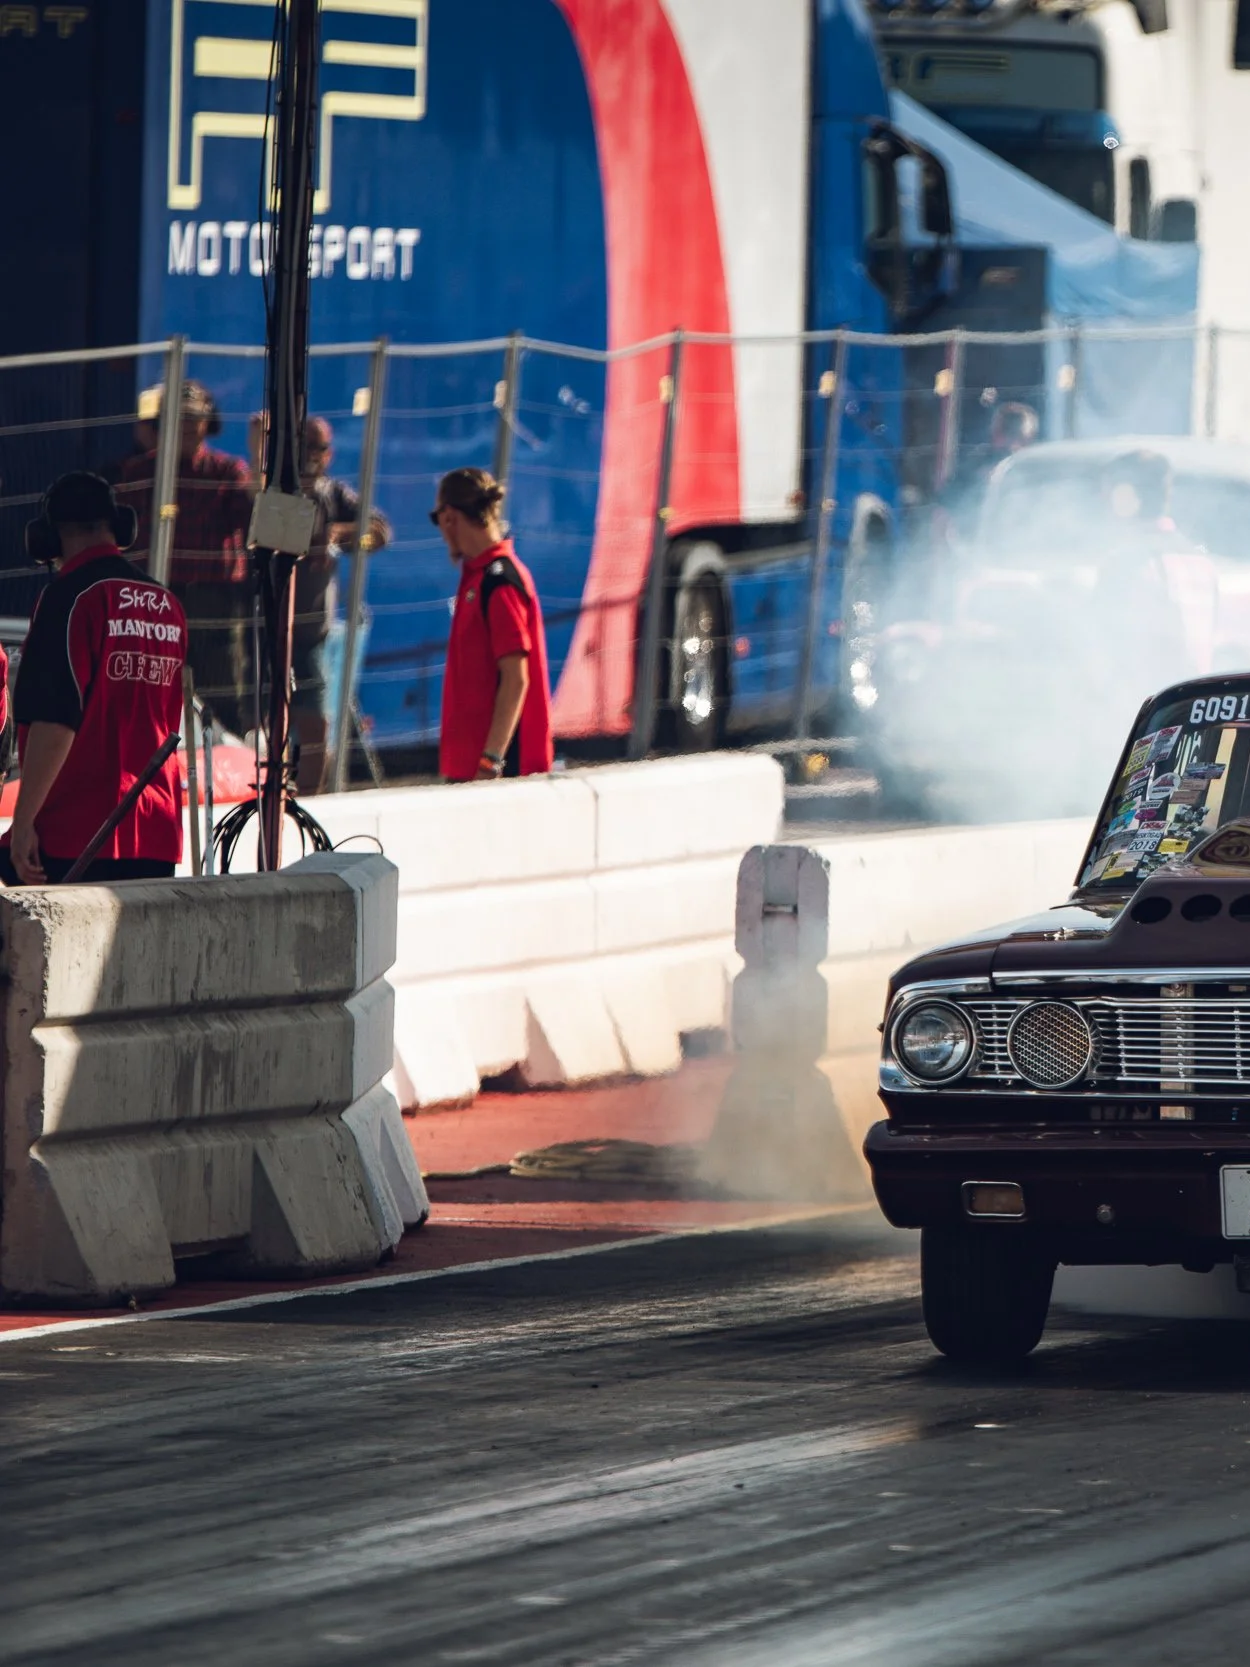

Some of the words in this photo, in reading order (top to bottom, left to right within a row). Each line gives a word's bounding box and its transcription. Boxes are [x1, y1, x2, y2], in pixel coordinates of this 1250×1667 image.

[167, 220, 422, 282] MOTOSPORT
[1188, 694, 1250, 724] 6091
[1128, 840, 1157, 851] 2018
